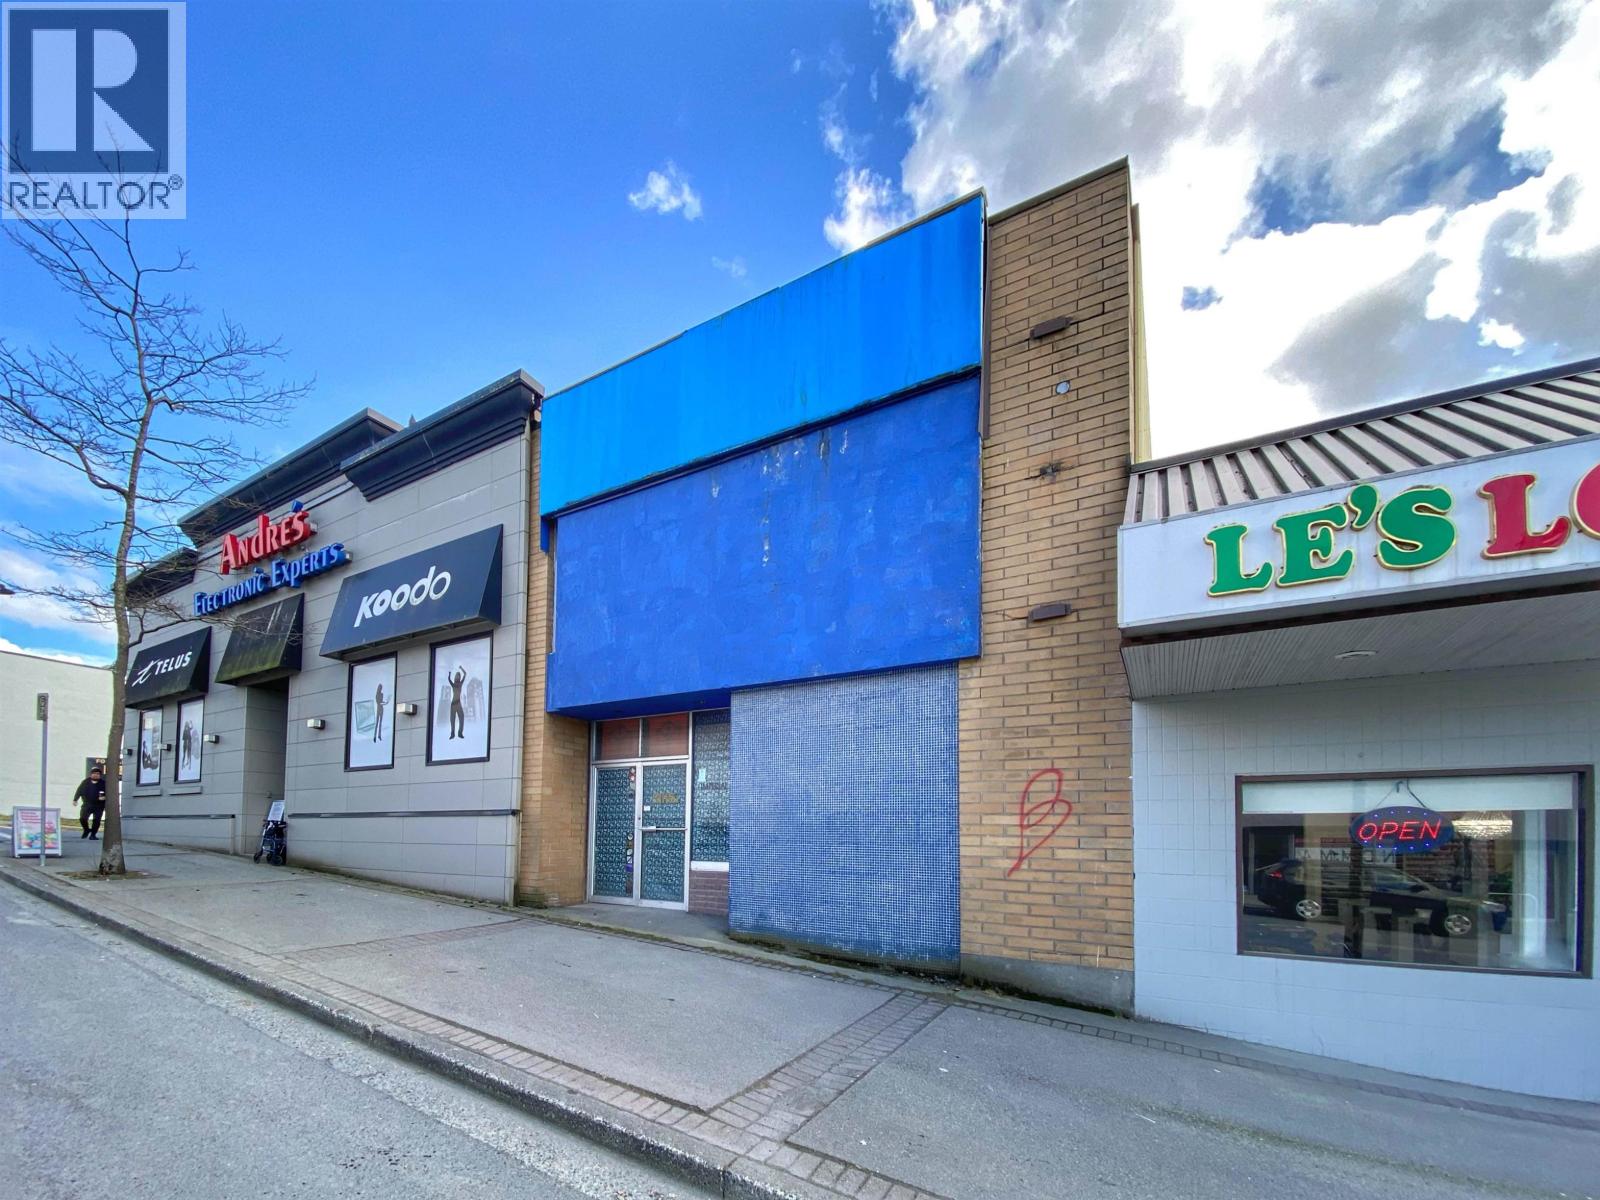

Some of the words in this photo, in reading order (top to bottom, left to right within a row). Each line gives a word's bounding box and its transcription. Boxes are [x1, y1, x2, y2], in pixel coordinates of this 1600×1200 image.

[1203, 484, 1458, 597] LE'S
[155, 651, 192, 676] TELUS
[1357, 819, 1443, 841] OPEN
